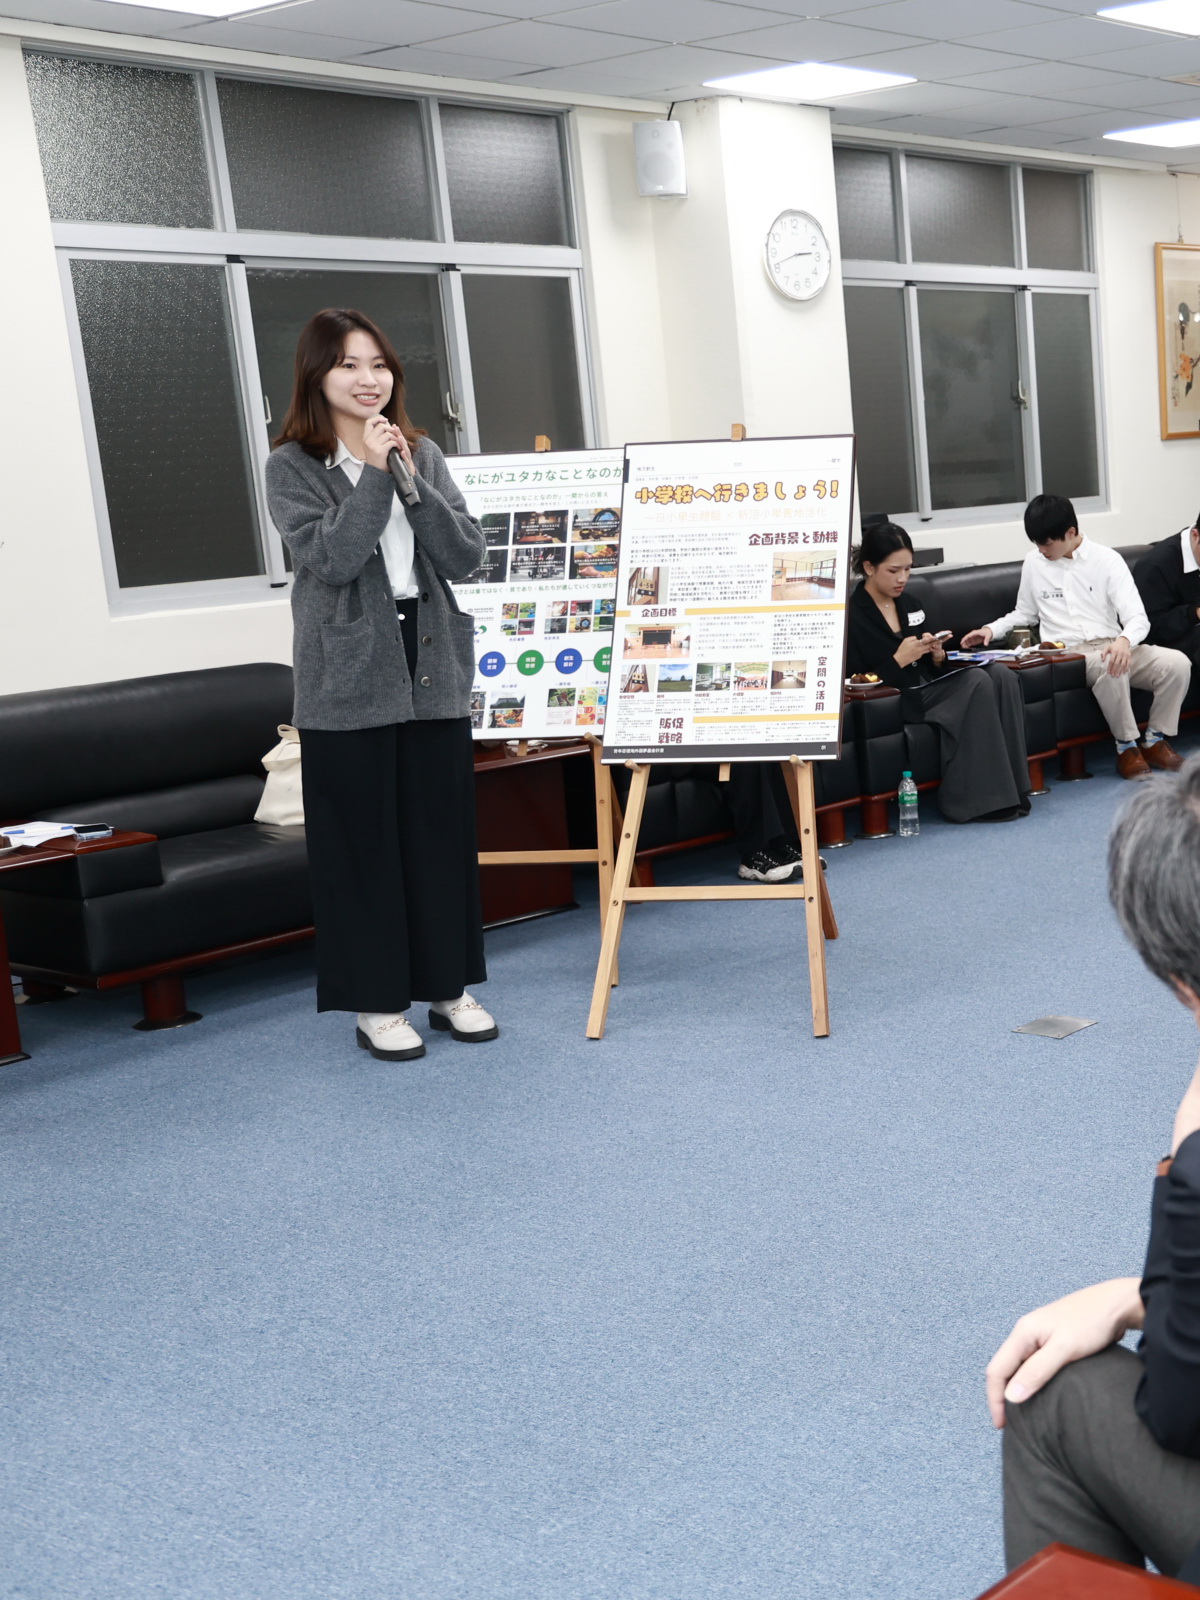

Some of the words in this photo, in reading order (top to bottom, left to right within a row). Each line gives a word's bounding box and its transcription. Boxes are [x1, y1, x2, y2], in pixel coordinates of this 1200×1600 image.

[780, 221, 787, 231] 11
[790, 218, 799, 229] 12
[772, 232, 781, 243] 10
[811, 236, 818, 246] 2
[770, 247, 778, 258] 9
[815, 252, 821, 262] 3
[773, 263, 781, 273] 8
[812, 267, 818, 276] 4
[784, 275, 790, 286] 7
[793, 280, 801, 291] 6
[804, 278, 811, 288] 5
[635, 480, 839, 505] 小学校へ行きましょう!
[748, 531, 839, 546] 企画背景と動機
[641, 607, 677, 618] 企画目標
[815, 656, 827, 712] 空間の活用
[659, 717, 684, 729] 販促
[658, 732, 683, 744] 戦略
